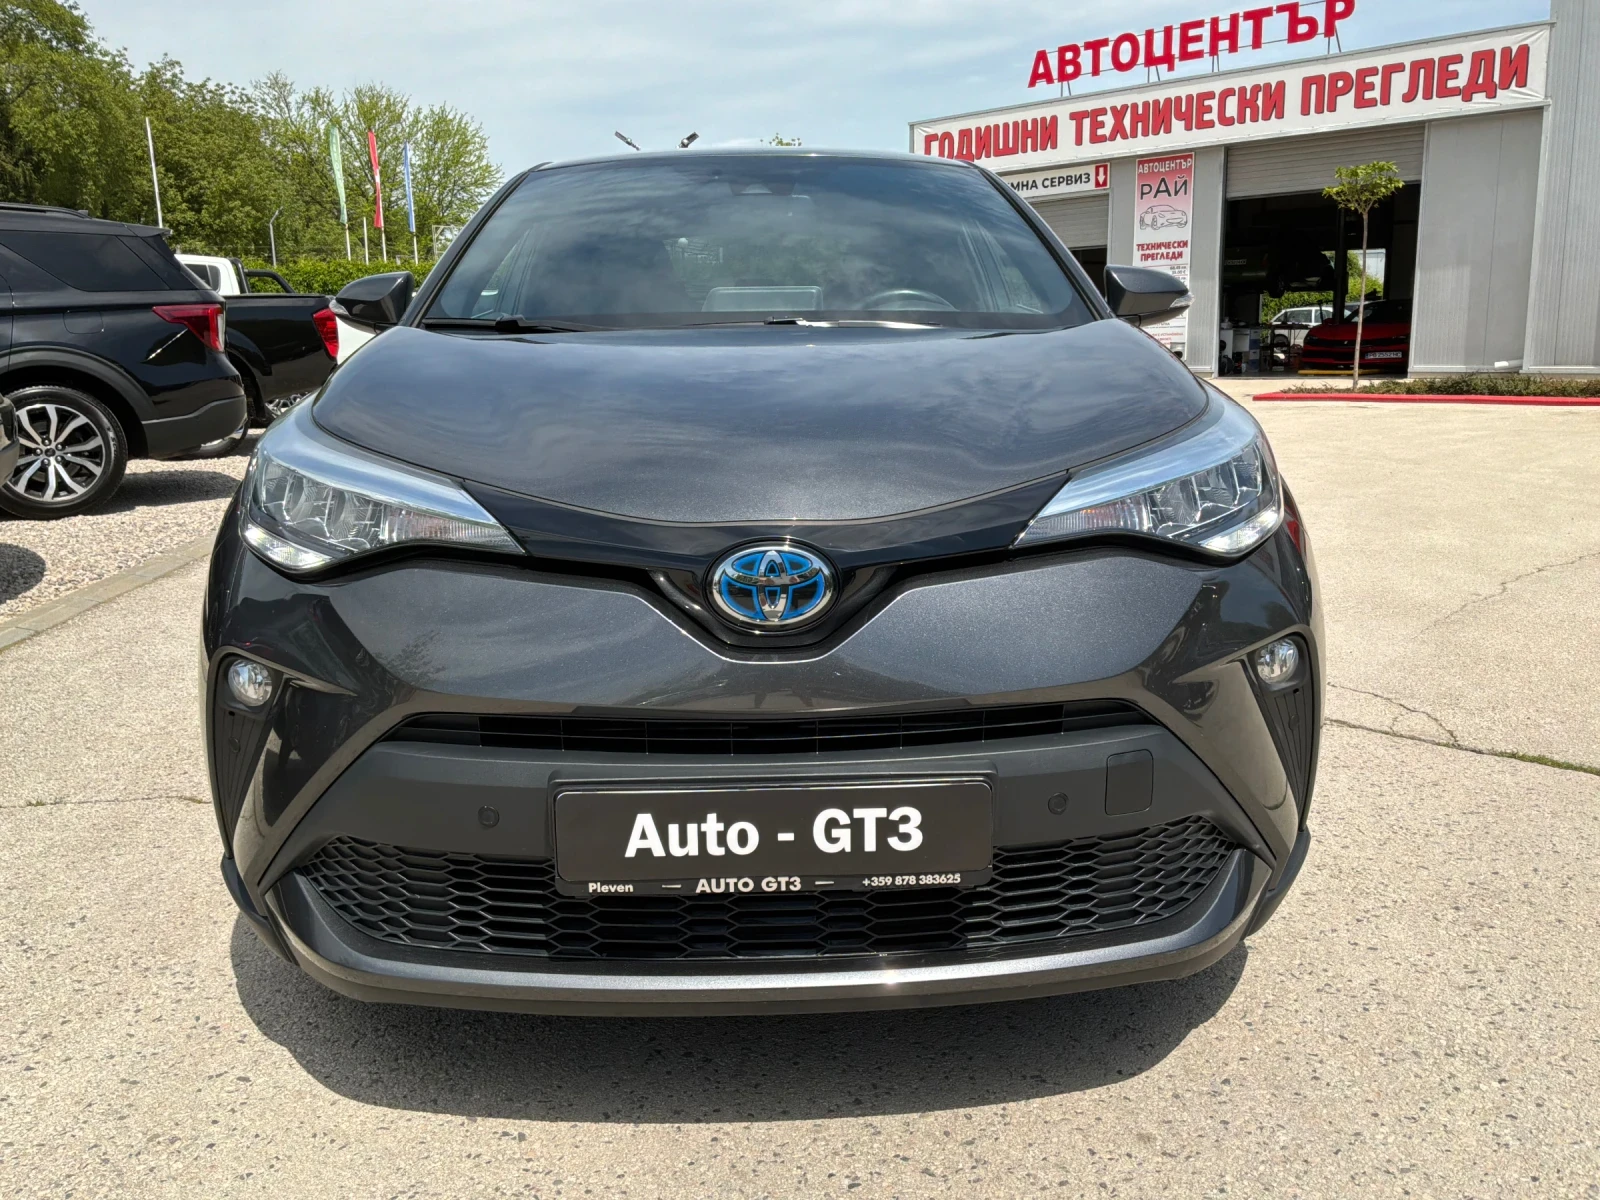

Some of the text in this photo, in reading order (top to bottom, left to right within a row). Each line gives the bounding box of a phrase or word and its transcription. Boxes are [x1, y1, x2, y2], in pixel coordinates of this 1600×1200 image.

[1027, 0, 1356, 89] АВТОЦЕНТЪР
[923, 43, 1531, 163] ГОДИШНИ ТЕХНИЧЕСКИ ПРЕГЛЕДИ
[1137, 158, 1192, 174] АВТОЦЕНТЪР
[1008, 172, 1091, 192] МНА СЕРВИЗ
[1140, 174, 1188, 200] РАЙ
[1136, 239, 1188, 252] ТЕХНИЧЕСКИ
[1140, 250, 1184, 262] ПРЕГЛЕДИ
[625, 812, 760, 858] Auto
[812, 806, 924, 854] GT3
[588, 873, 961, 894] Pleven AUTO GT3 +359 878 383625
